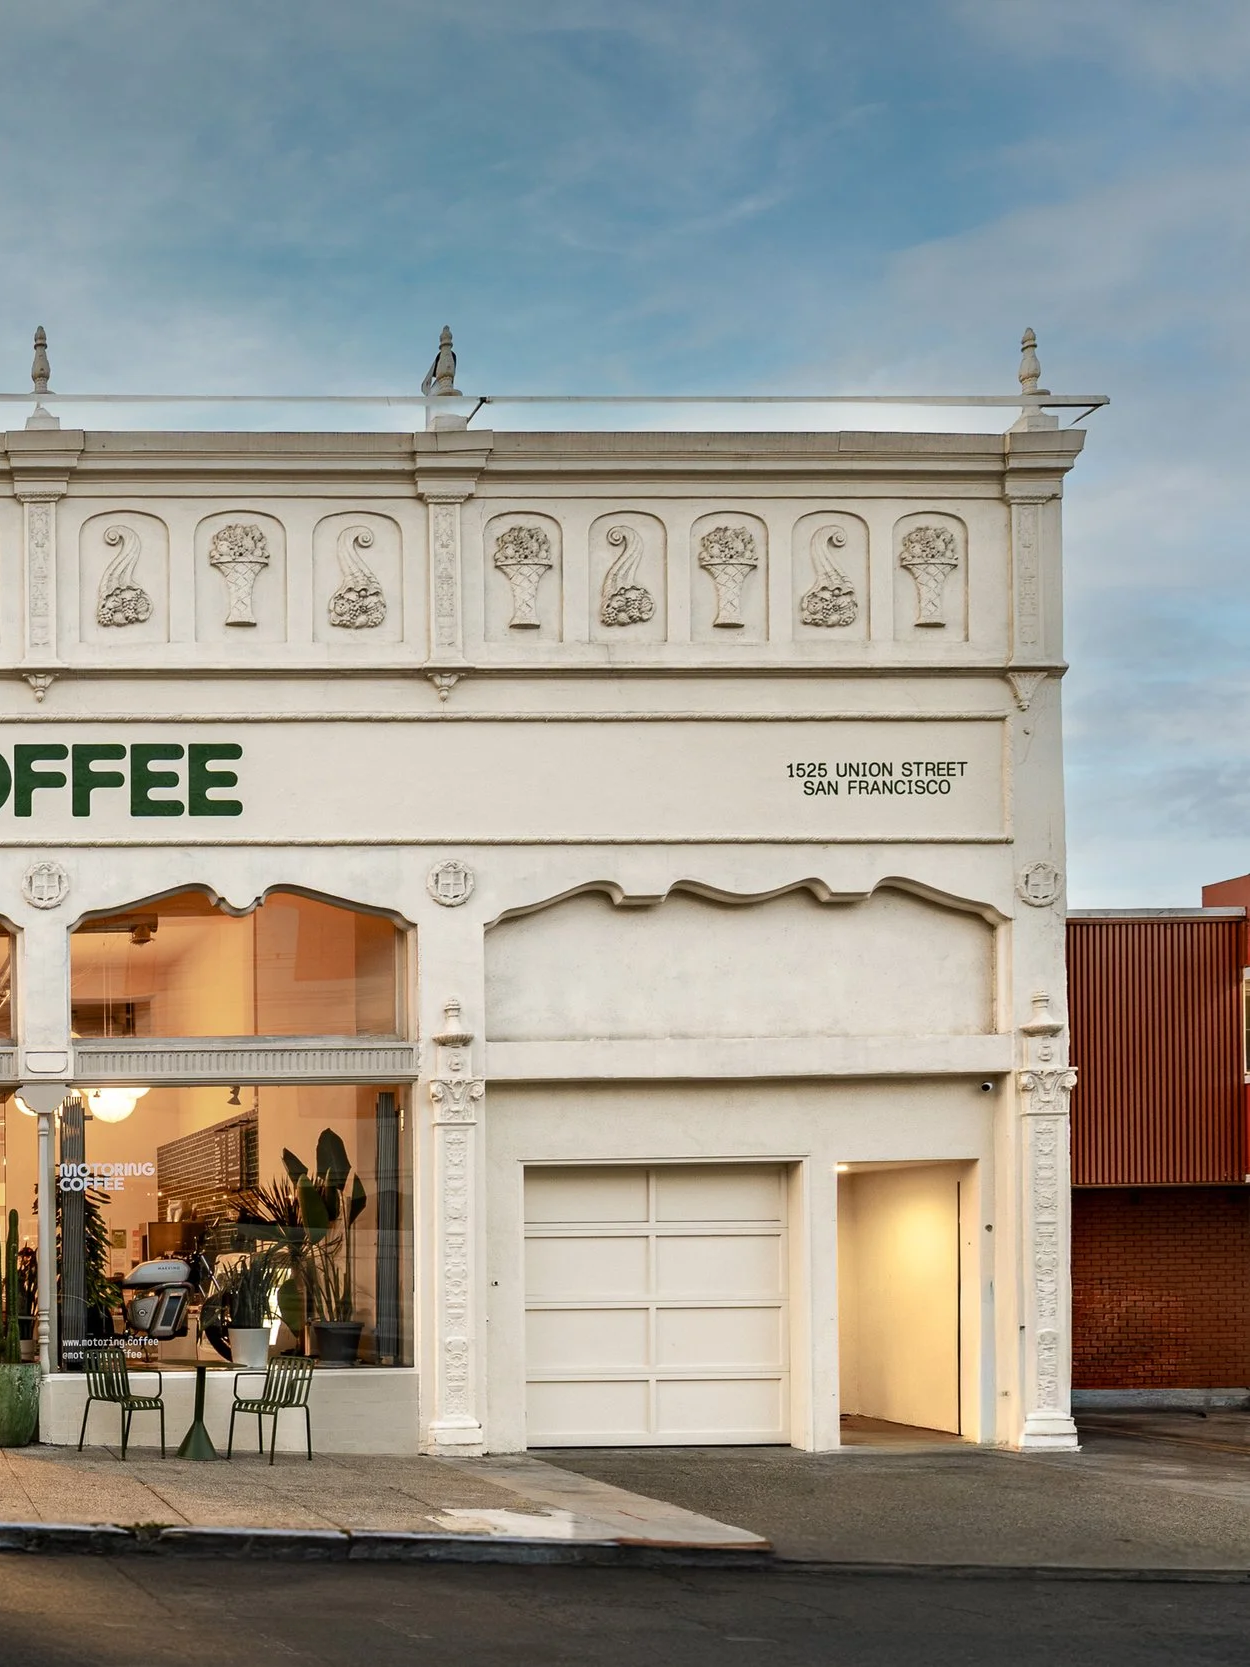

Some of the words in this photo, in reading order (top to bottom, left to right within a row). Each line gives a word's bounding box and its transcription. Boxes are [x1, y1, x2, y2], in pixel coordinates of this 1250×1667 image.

[786, 762, 828, 778] 1525
[836, 762, 893, 778] UNION
[901, 761, 968, 777] STREET
[803, 781, 839, 796] SAN
[847, 779, 951, 795] FRANCISCO
[59, 1162, 156, 1177] MOTORING
[59, 1177, 125, 1191] COFFEE
[62, 1336, 159, 1349] www.motoring.coffee
